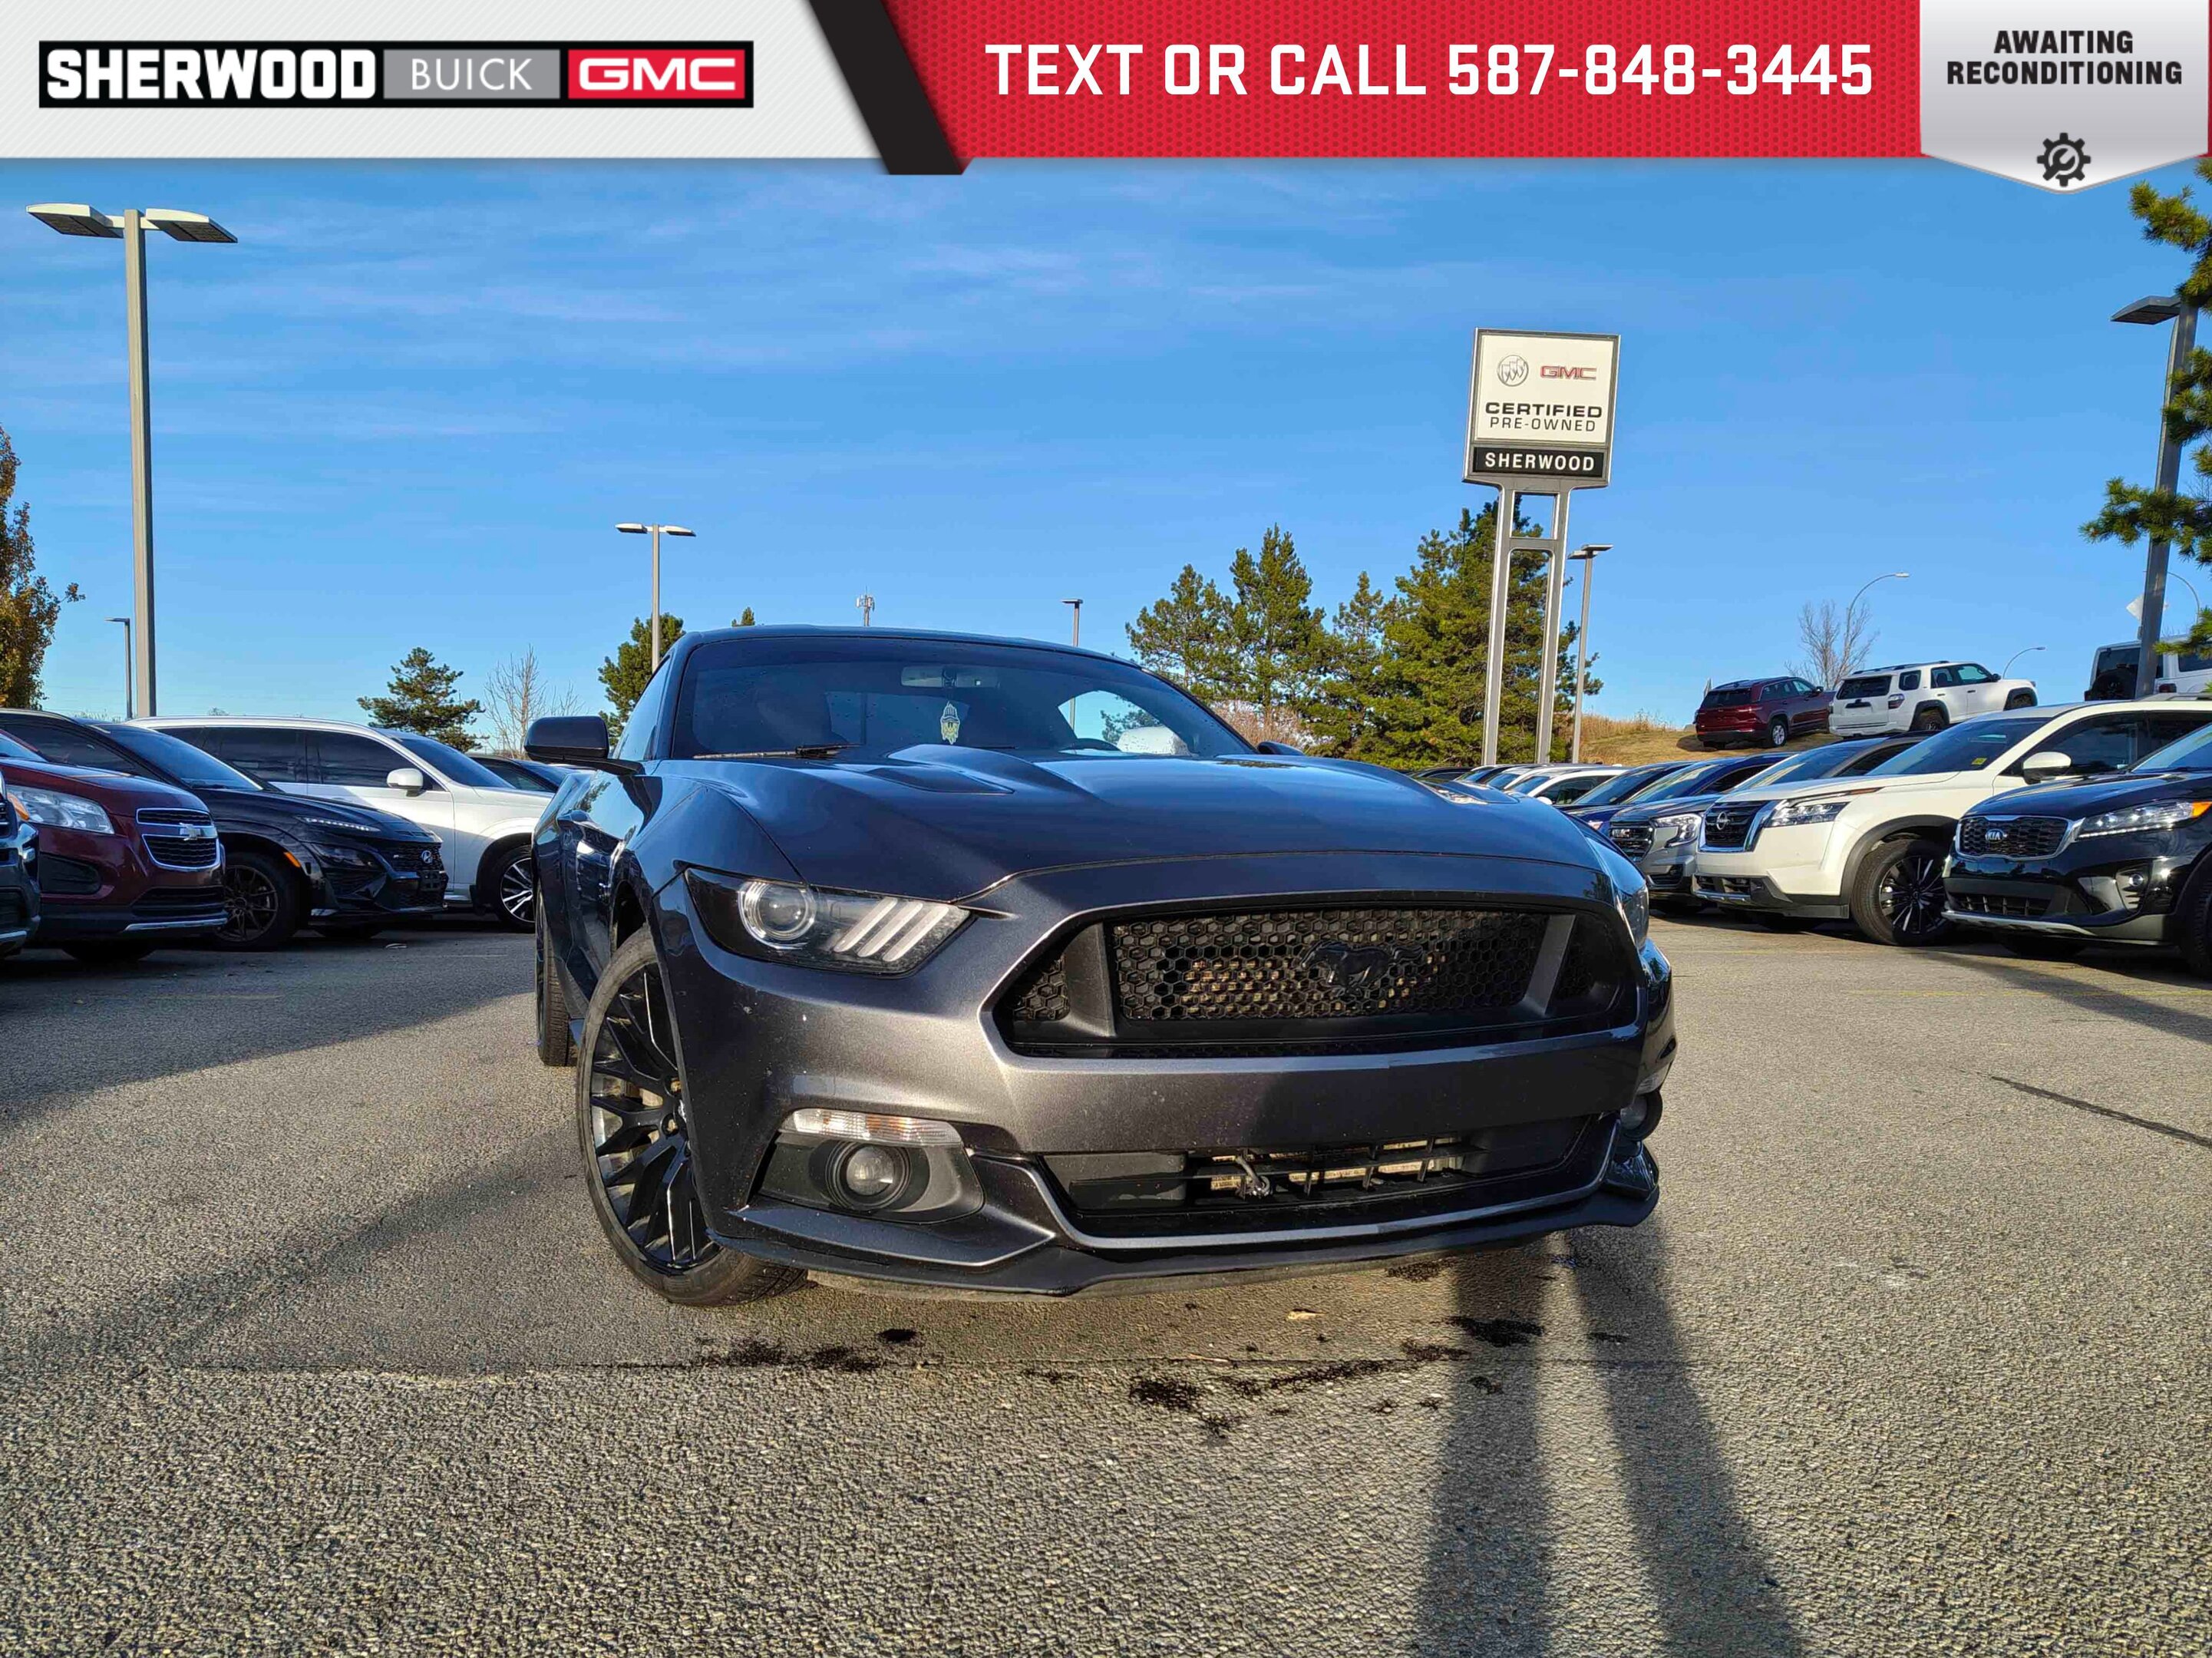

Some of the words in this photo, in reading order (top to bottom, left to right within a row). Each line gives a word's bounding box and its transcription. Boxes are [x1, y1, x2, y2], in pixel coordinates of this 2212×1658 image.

[1540, 365, 1597, 381] GMC
[1485, 402, 1603, 418] CERTIFIED
[1490, 417, 1596, 432] PRE-OWNED
[1484, 452, 1595, 471] SHERWOOD
